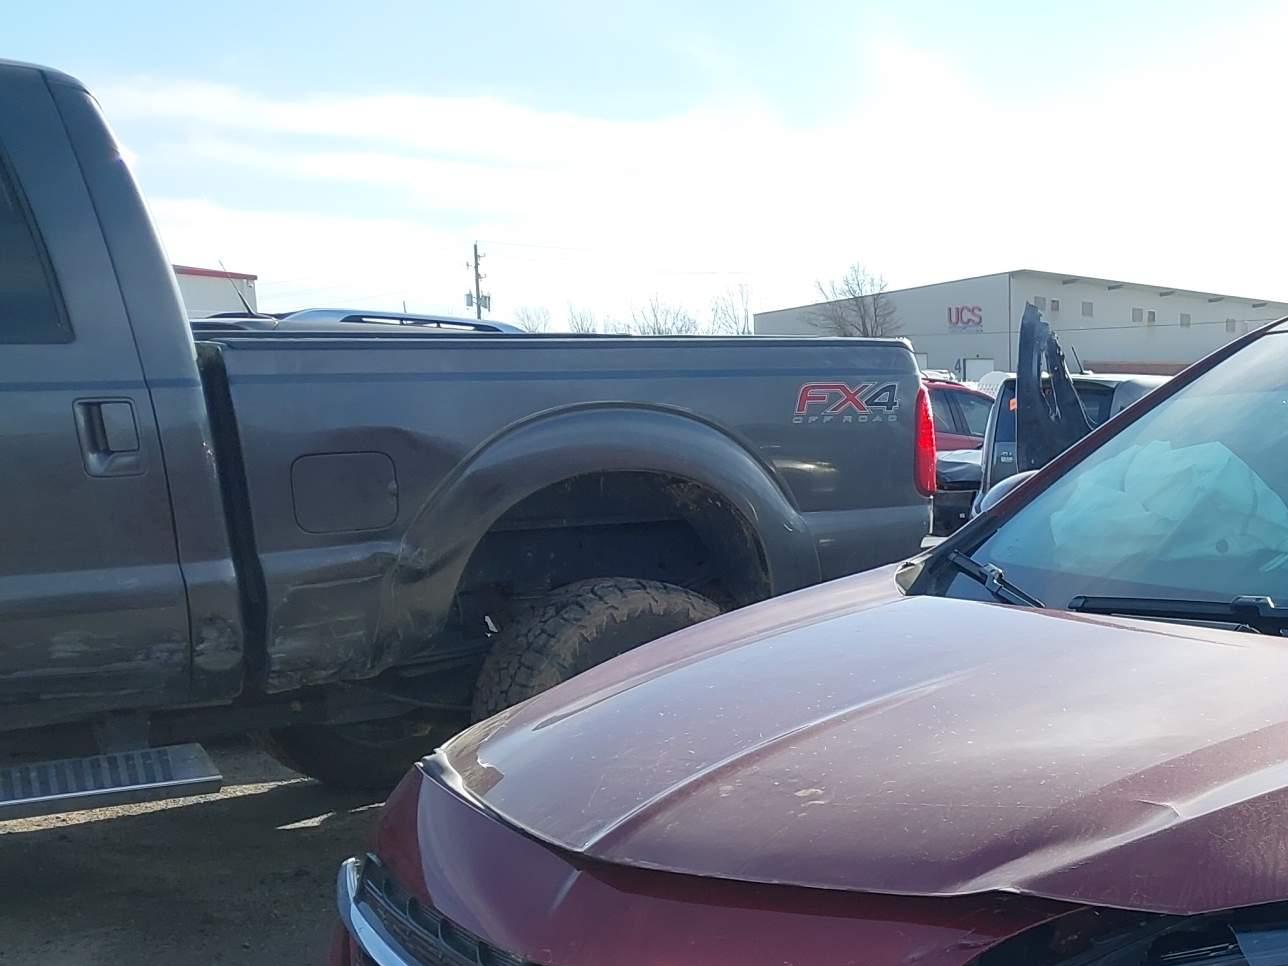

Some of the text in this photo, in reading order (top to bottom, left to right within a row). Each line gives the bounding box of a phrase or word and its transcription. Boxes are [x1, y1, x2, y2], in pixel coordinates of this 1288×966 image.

[947, 305, 983, 326] UCS
[794, 382, 899, 415] FX4
[792, 415, 898, 424] OFF ROAD
